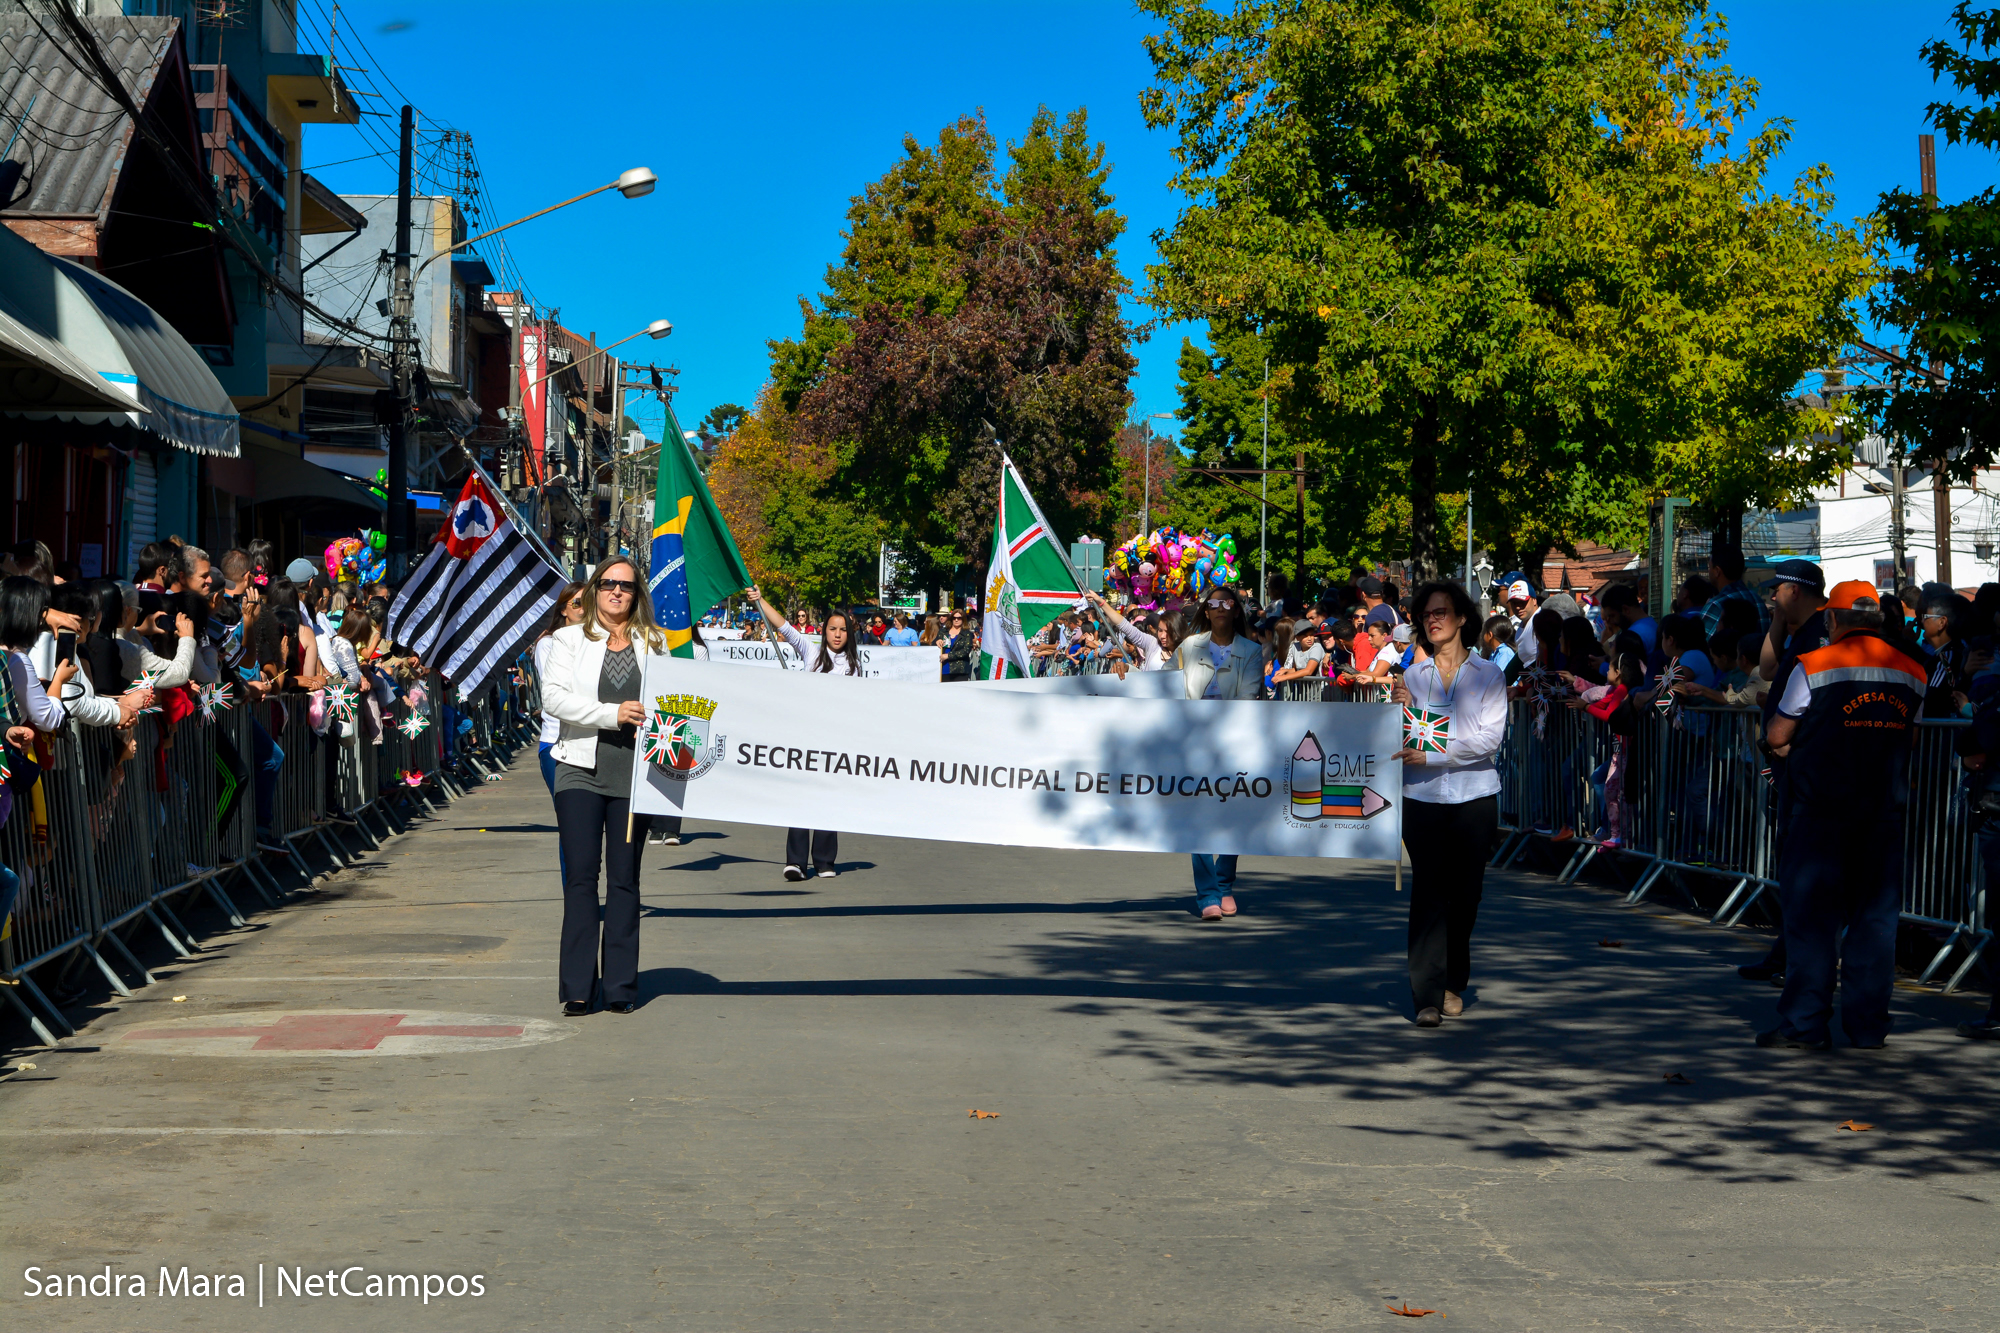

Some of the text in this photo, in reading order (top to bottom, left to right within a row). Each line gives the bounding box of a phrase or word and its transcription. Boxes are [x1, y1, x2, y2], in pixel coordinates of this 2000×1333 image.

[1843, 692, 1908, 717] DEFESA CIVIL
[1843, 720, 1873, 728] CAMPOS
[737, 743, 1273, 803] SECRETARIA MUNICIPAL DE EDUCAÇÃO
[1327, 754, 1375, 777] S.M.E
[1283, 804, 1311, 829] MUNICIPAL
